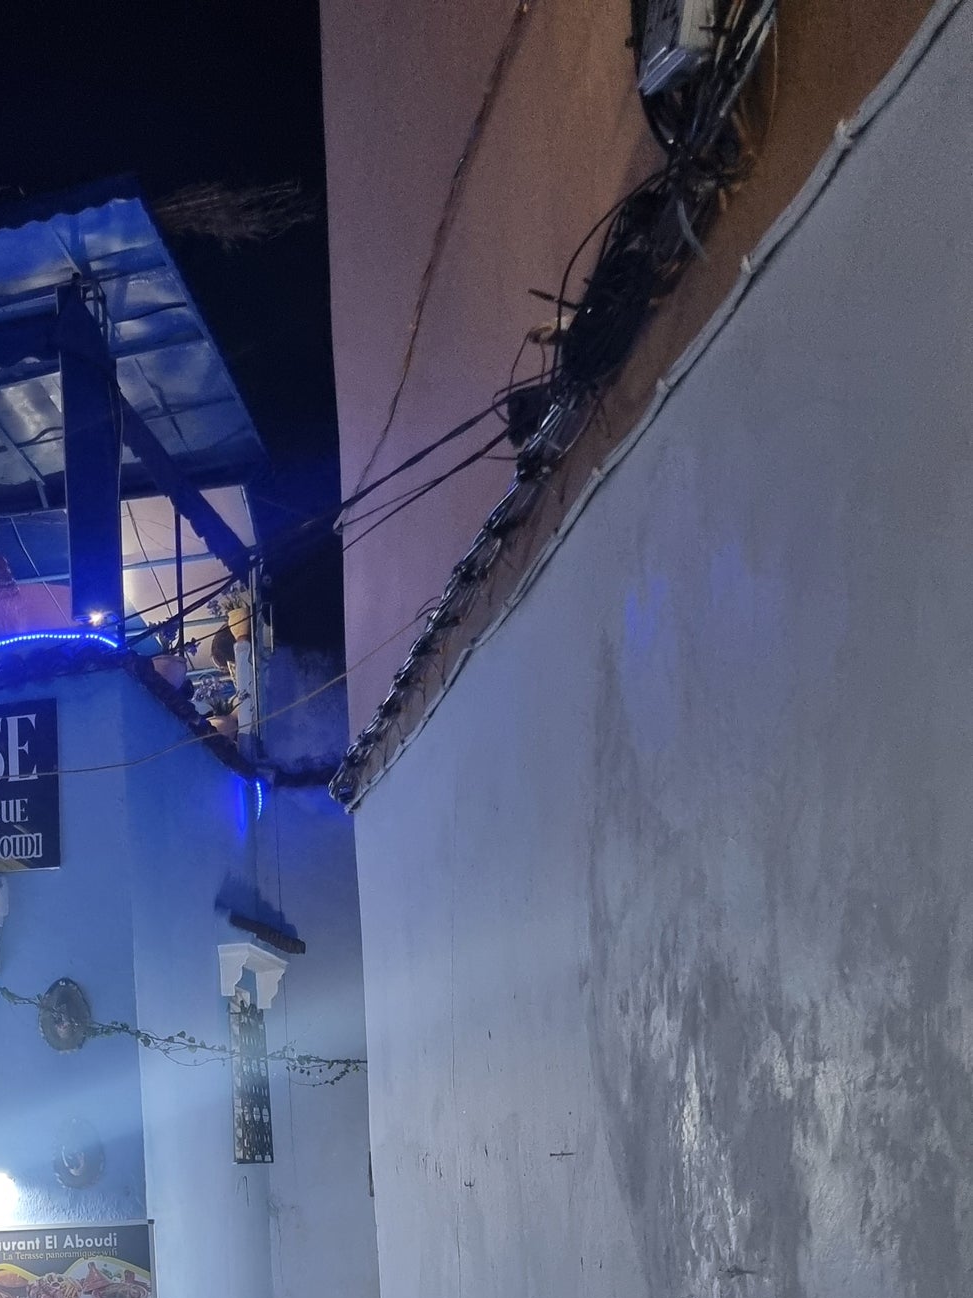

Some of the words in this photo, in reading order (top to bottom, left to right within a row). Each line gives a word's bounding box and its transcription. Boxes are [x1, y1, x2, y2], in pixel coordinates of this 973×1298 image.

[45, 1235, 58, 1250] El
[63, 1233, 118, 1249] Aboudi
[3, 1253, 13, 1261] La
[15, 1252, 43, 1261] Terasse
